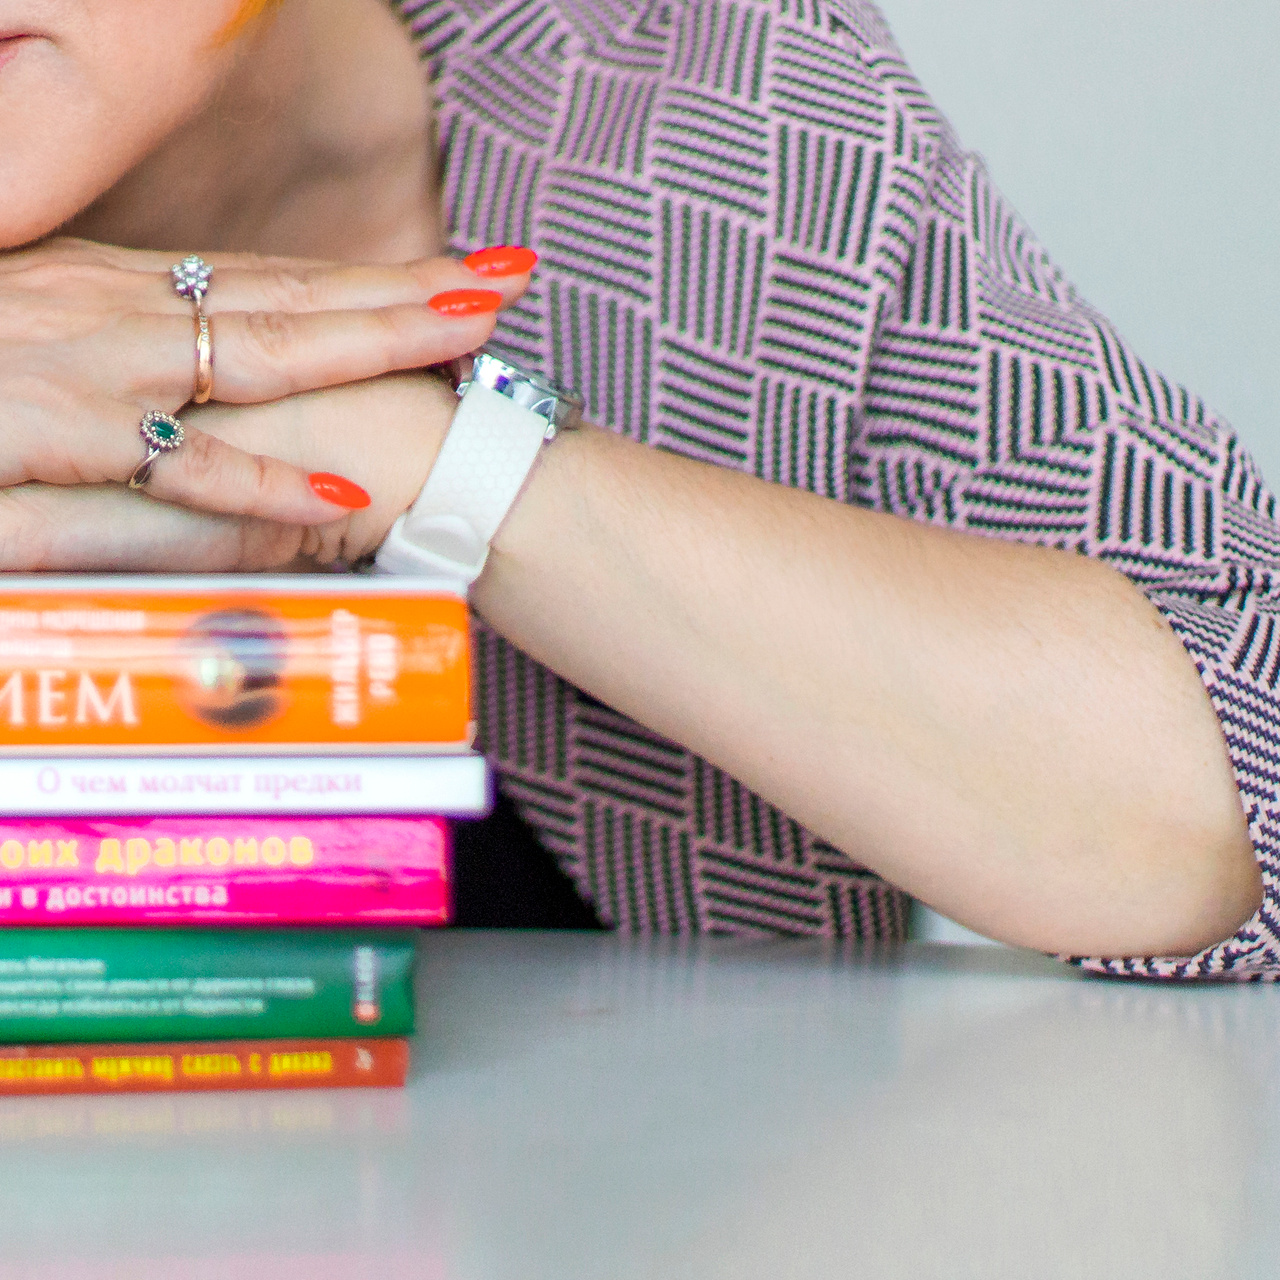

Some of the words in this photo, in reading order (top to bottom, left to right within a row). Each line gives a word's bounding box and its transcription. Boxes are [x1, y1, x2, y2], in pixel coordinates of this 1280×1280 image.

[36, 766, 62, 795] О
[70, 775, 128, 795] чем
[137, 774, 246, 795] молчат
[253, 773, 363, 801] предки
[95, 836, 315, 876] драконов
[21, 886, 39, 908] в
[45, 882, 229, 911] достоинства
